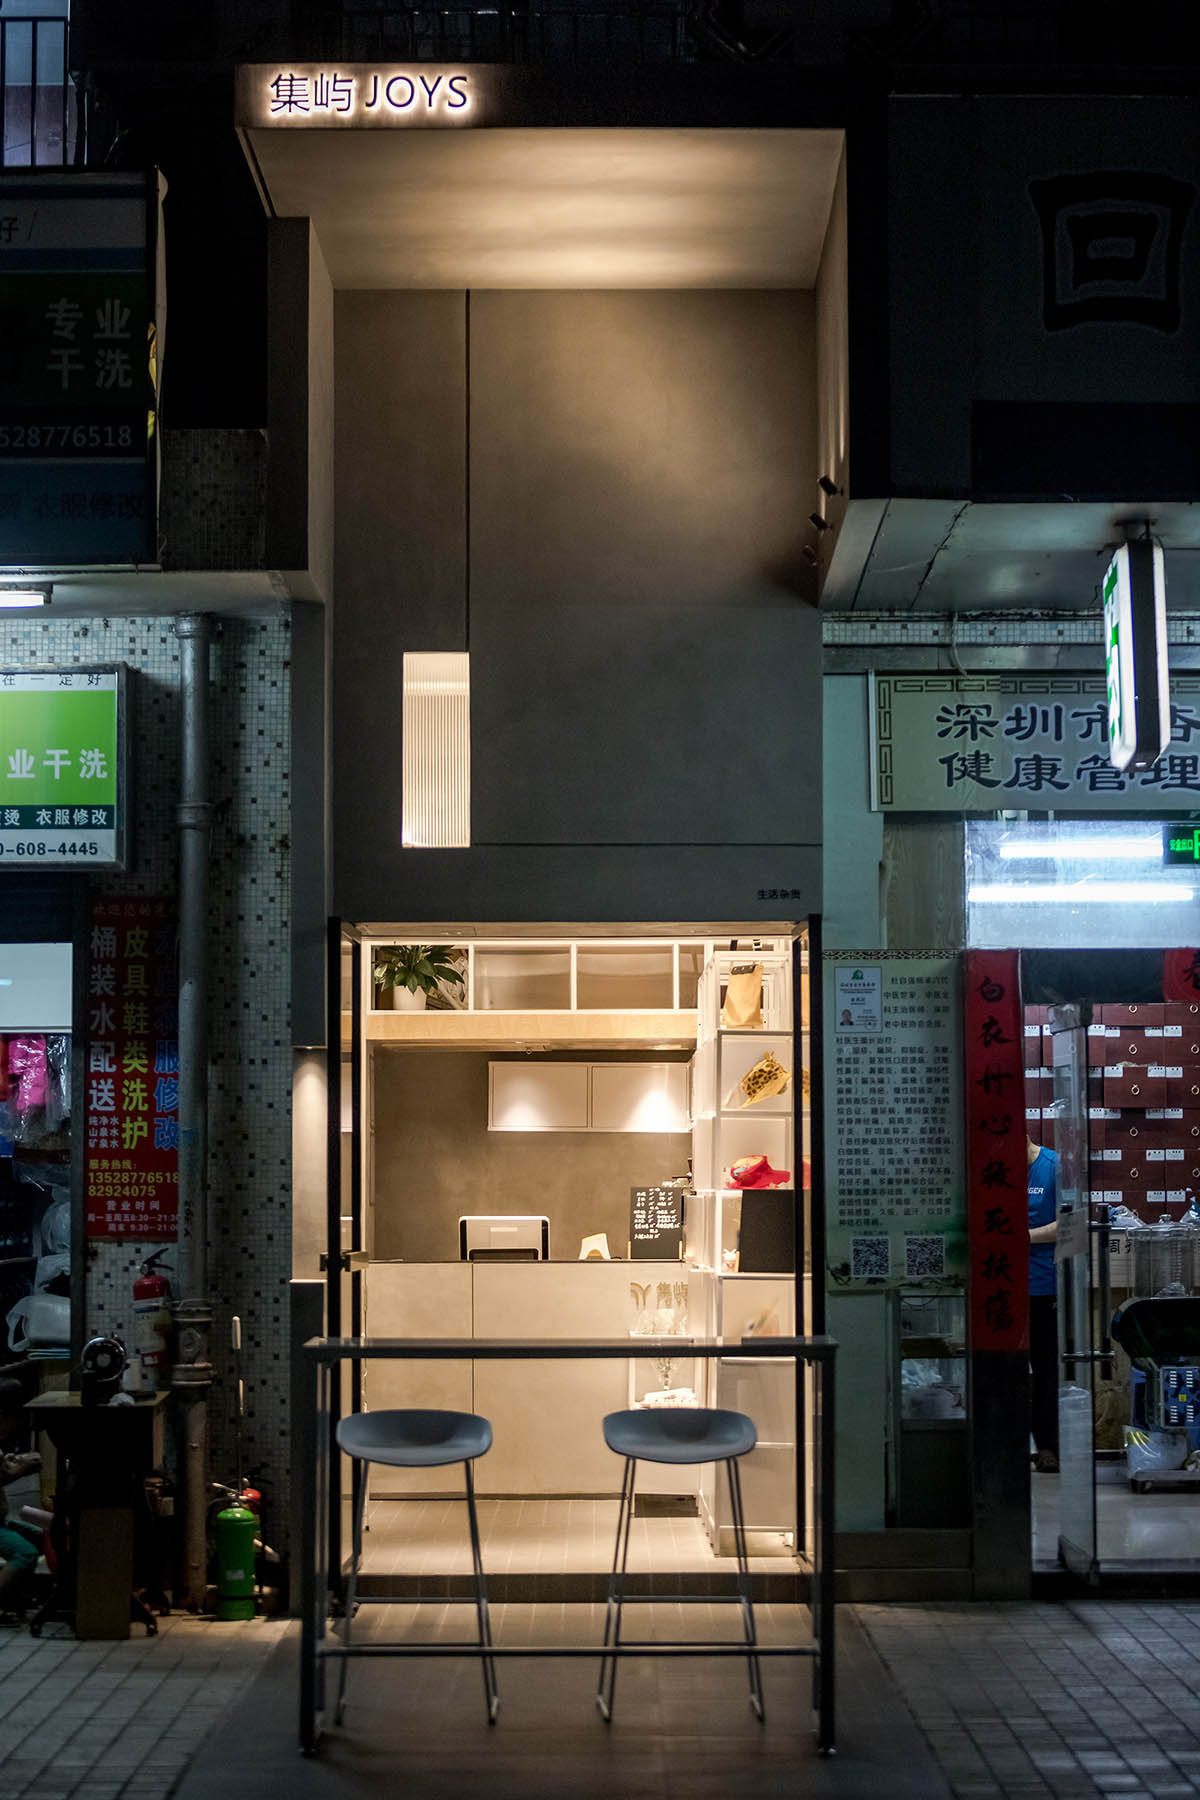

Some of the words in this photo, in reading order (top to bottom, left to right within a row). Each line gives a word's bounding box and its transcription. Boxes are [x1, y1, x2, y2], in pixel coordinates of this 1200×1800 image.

[271, 73, 353, 112] 集屿
[365, 75, 467, 108] JOYS
[44, 297, 132, 342] 专业
[47, 347, 133, 390] 干洗
[7, 748, 108, 780] 业干洗
[938, 749, 1200, 791] 健康管理
[36, 809, 107, 825] 衣服修改
[88, 924, 118, 1112] 桶装水配送
[121, 924, 150, 1150] 皮具鞋类洗护
[89, 1127, 119, 1137] 山泉水
[89, 1138, 119, 1149] 矿泉水
[88, 1172, 179, 1184] 13528776518
[88, 1185, 156, 1197] 82924075
[106, 1200, 160, 1211] 营业时间
